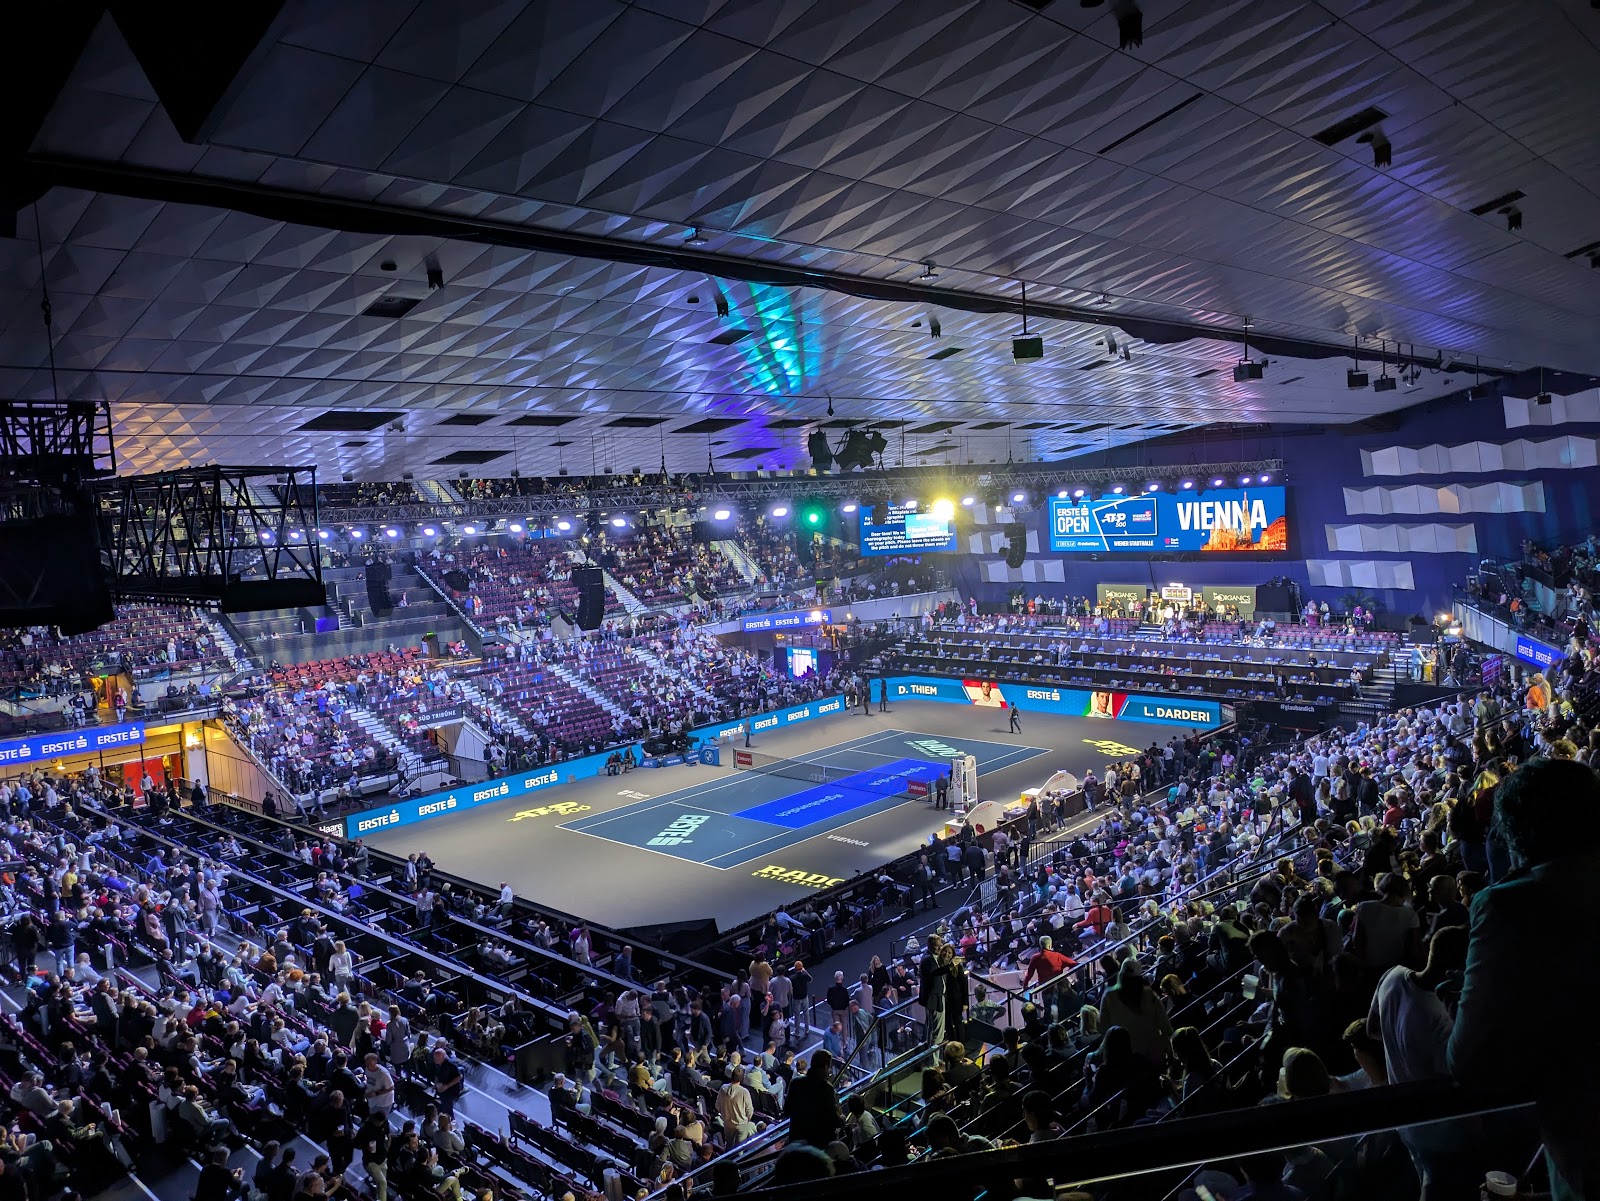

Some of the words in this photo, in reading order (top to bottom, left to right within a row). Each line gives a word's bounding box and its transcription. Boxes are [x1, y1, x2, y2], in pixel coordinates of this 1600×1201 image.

[1101, 513, 1126, 523] ATP
[1177, 500, 1267, 530] VIENNA
[1058, 517, 1089, 532] OPEN
[1518, 644, 1529, 657] ERSTE
[1536, 652, 1547, 664] ERSTE
[898, 686, 908, 694] D.
[910, 685, 937, 695] THIEM
[1027, 690, 1051, 700] ERSTE
[819, 703, 834, 713] ERSTE
[1144, 706, 1154, 717] L.
[1157, 707, 1210, 722] DARDERI
[1280, 704, 1315, 712] #glaubandich
[432, 710, 456, 719] TRIBÜNE
[788, 711, 804, 721] ERSTE
[755, 718, 772, 729] ERSTE
[720, 727, 738, 737] ERSTE
[97, 732, 128, 745] ERSTE
[42, 741, 75, 754] ERSTE
[0, 748, 18, 760] STE
[525, 777, 549, 788] ERSTE
[908, 784, 927, 792] Emirates
[474, 788, 499, 801] ERSTE
[419, 801, 446, 816] ERSTE
[507, 801, 578, 822] ATP
[559, 804, 592, 816] 500
[359, 815, 388, 831] ERSTE
[657, 814, 710, 837] ERSTE
[826, 834, 870, 847] VIENNA
[751, 871, 829, 889] SWITZERLAN
